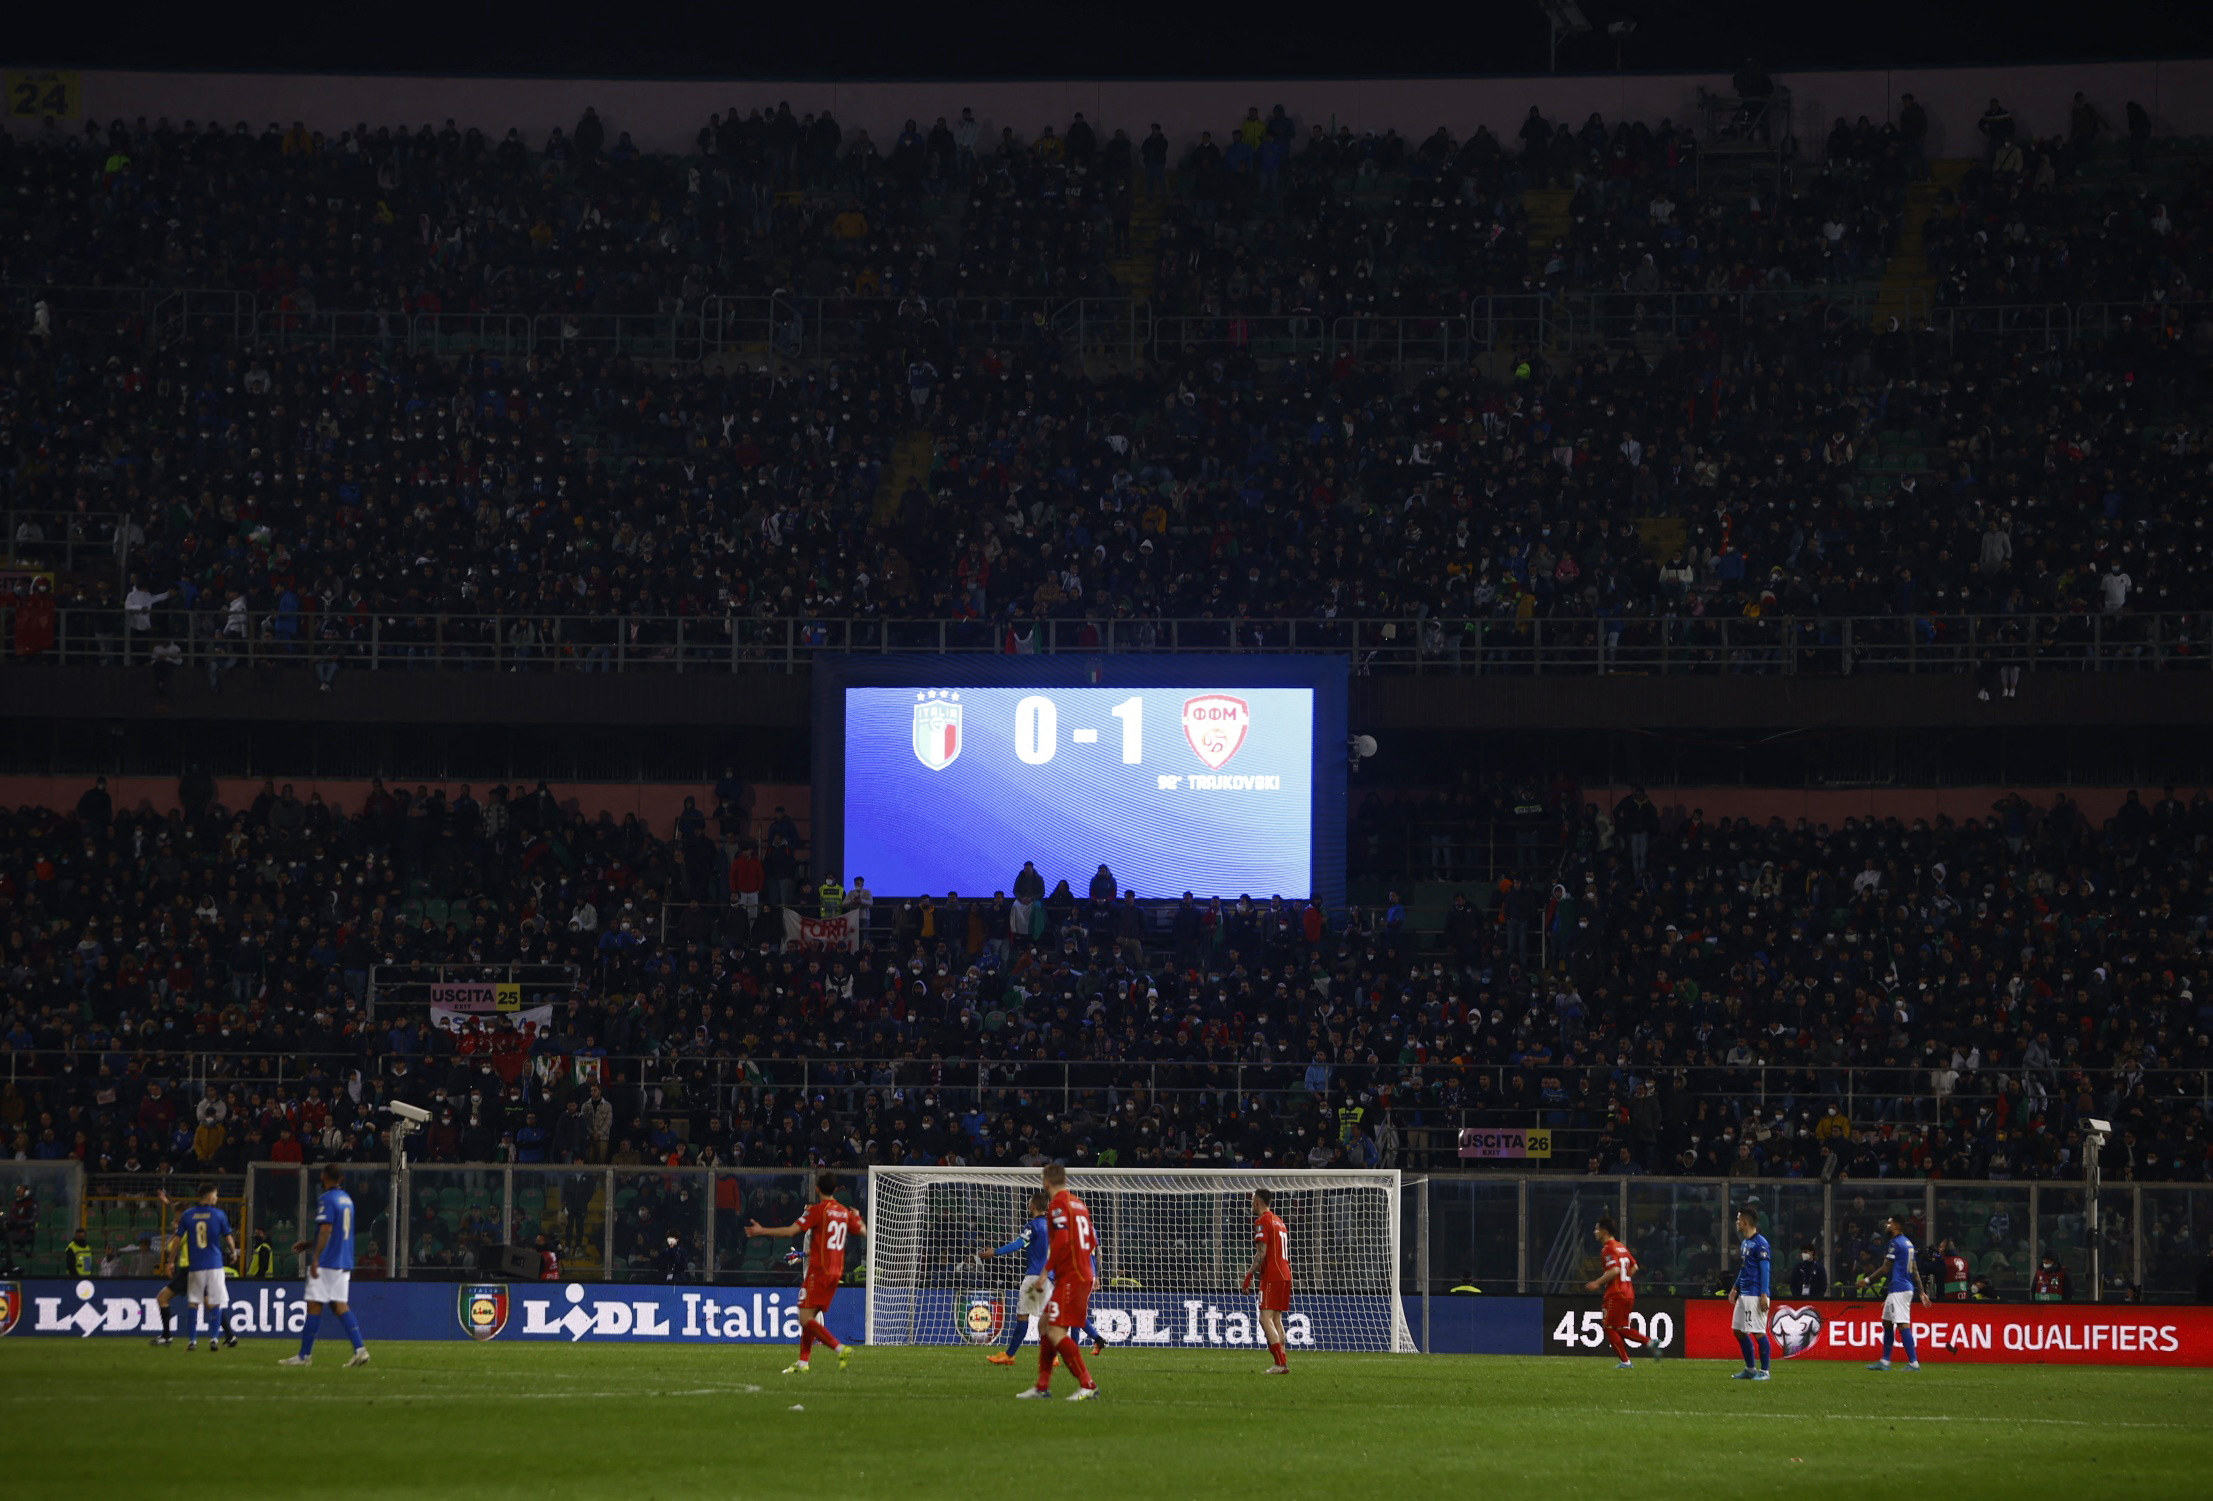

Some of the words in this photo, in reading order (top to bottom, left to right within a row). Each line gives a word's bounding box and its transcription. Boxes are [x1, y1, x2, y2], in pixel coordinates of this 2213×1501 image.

[15, 84, 65, 114] 24
[918, 707, 958, 719] ITALIA
[1015, 695, 1056, 764] 0
[1111, 697, 1143, 764] 1
[1188, 775, 1280, 790] TRAJKOVSKI
[432, 989, 495, 1002] USCITA
[498, 992, 518, 1005] 25
[1460, 1134, 1524, 1147] USCITA
[1528, 1137, 1549, 1150] 26
[196, 1221, 208, 1249] 8
[827, 1220, 848, 1251] 20
[35, 1280, 178, 1337] LIDL
[522, 1283, 670, 1342] LIDL
[682, 1293, 801, 1338] Italia
[1183, 1300, 1314, 1345] Itala
[1553, 1311, 1673, 1348] 4500
[2004, 1323, 2179, 1351] QUALIFIERS
